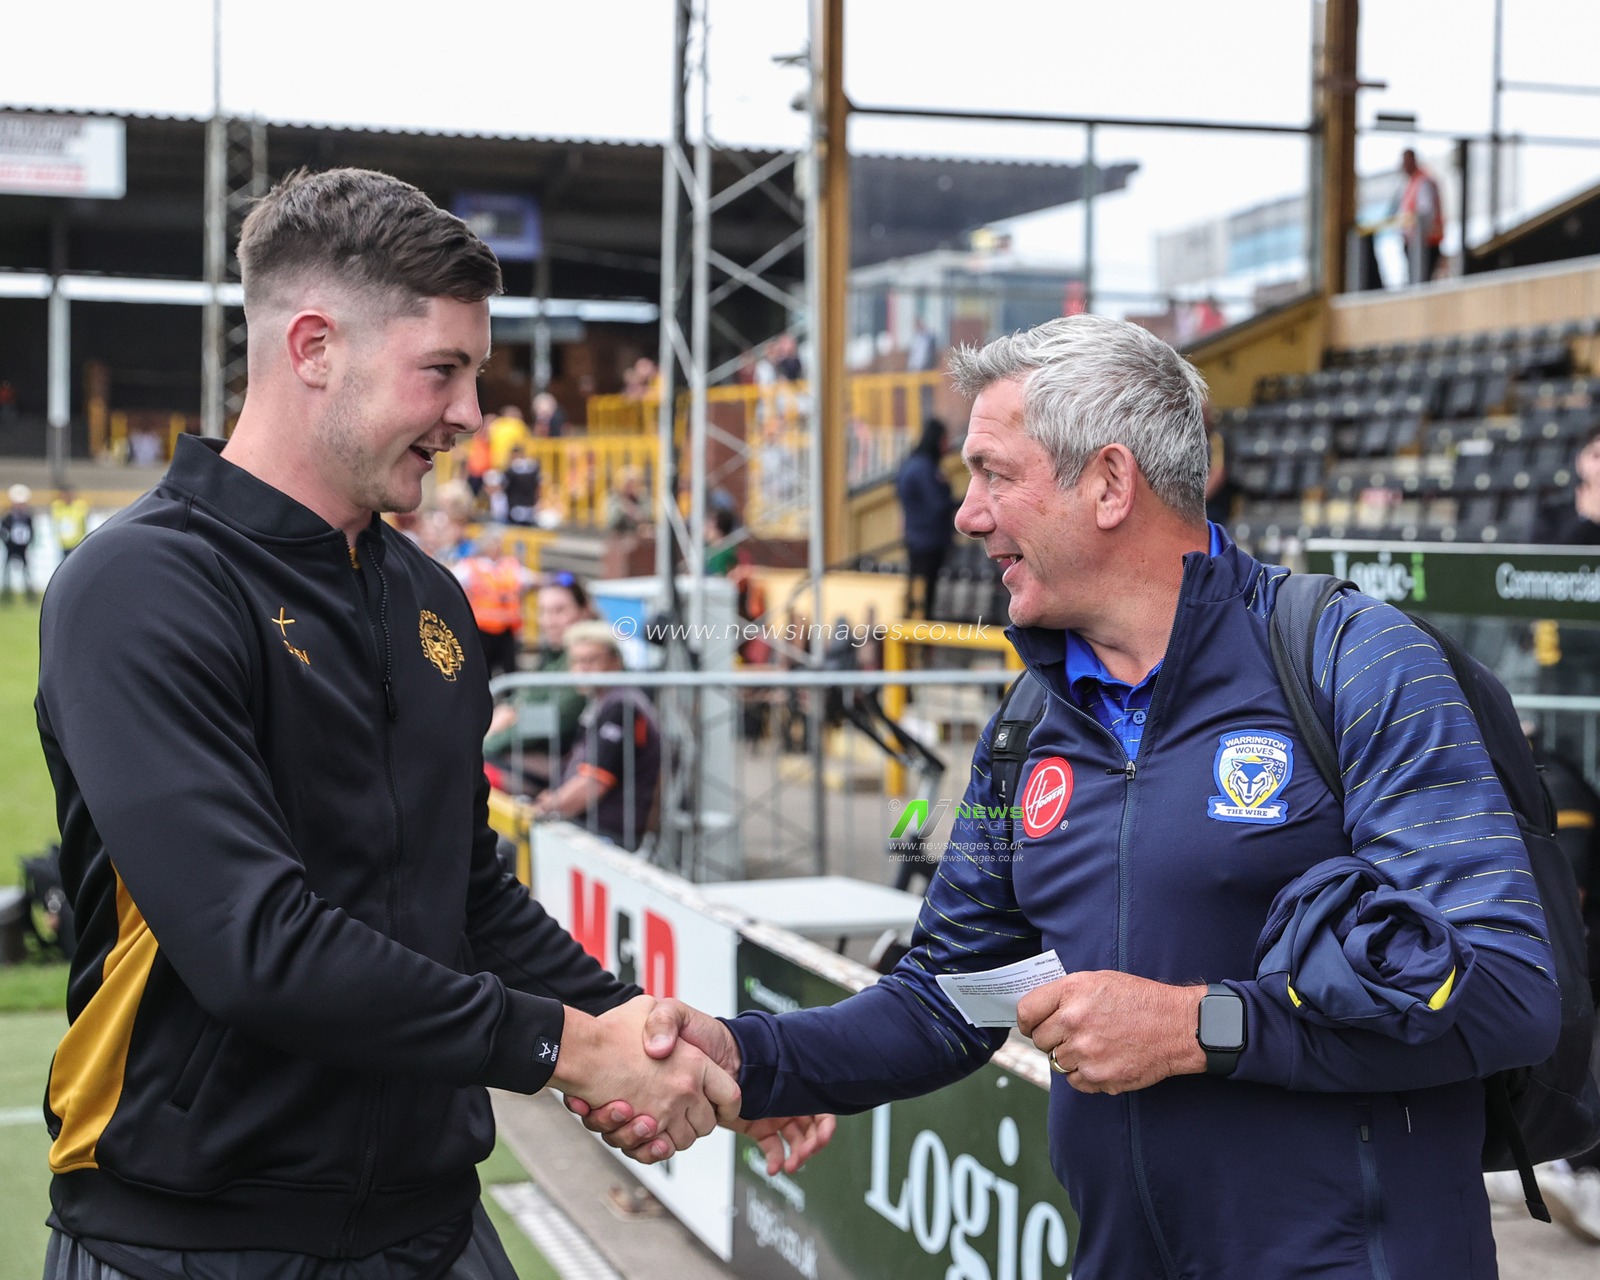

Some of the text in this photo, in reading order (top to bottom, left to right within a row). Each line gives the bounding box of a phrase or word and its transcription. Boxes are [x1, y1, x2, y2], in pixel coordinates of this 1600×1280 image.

[1224, 736, 1287, 751] WARRINGTON
[1235, 746, 1274, 756] WOLVES
[1245, 809, 1268, 817] WIRE
